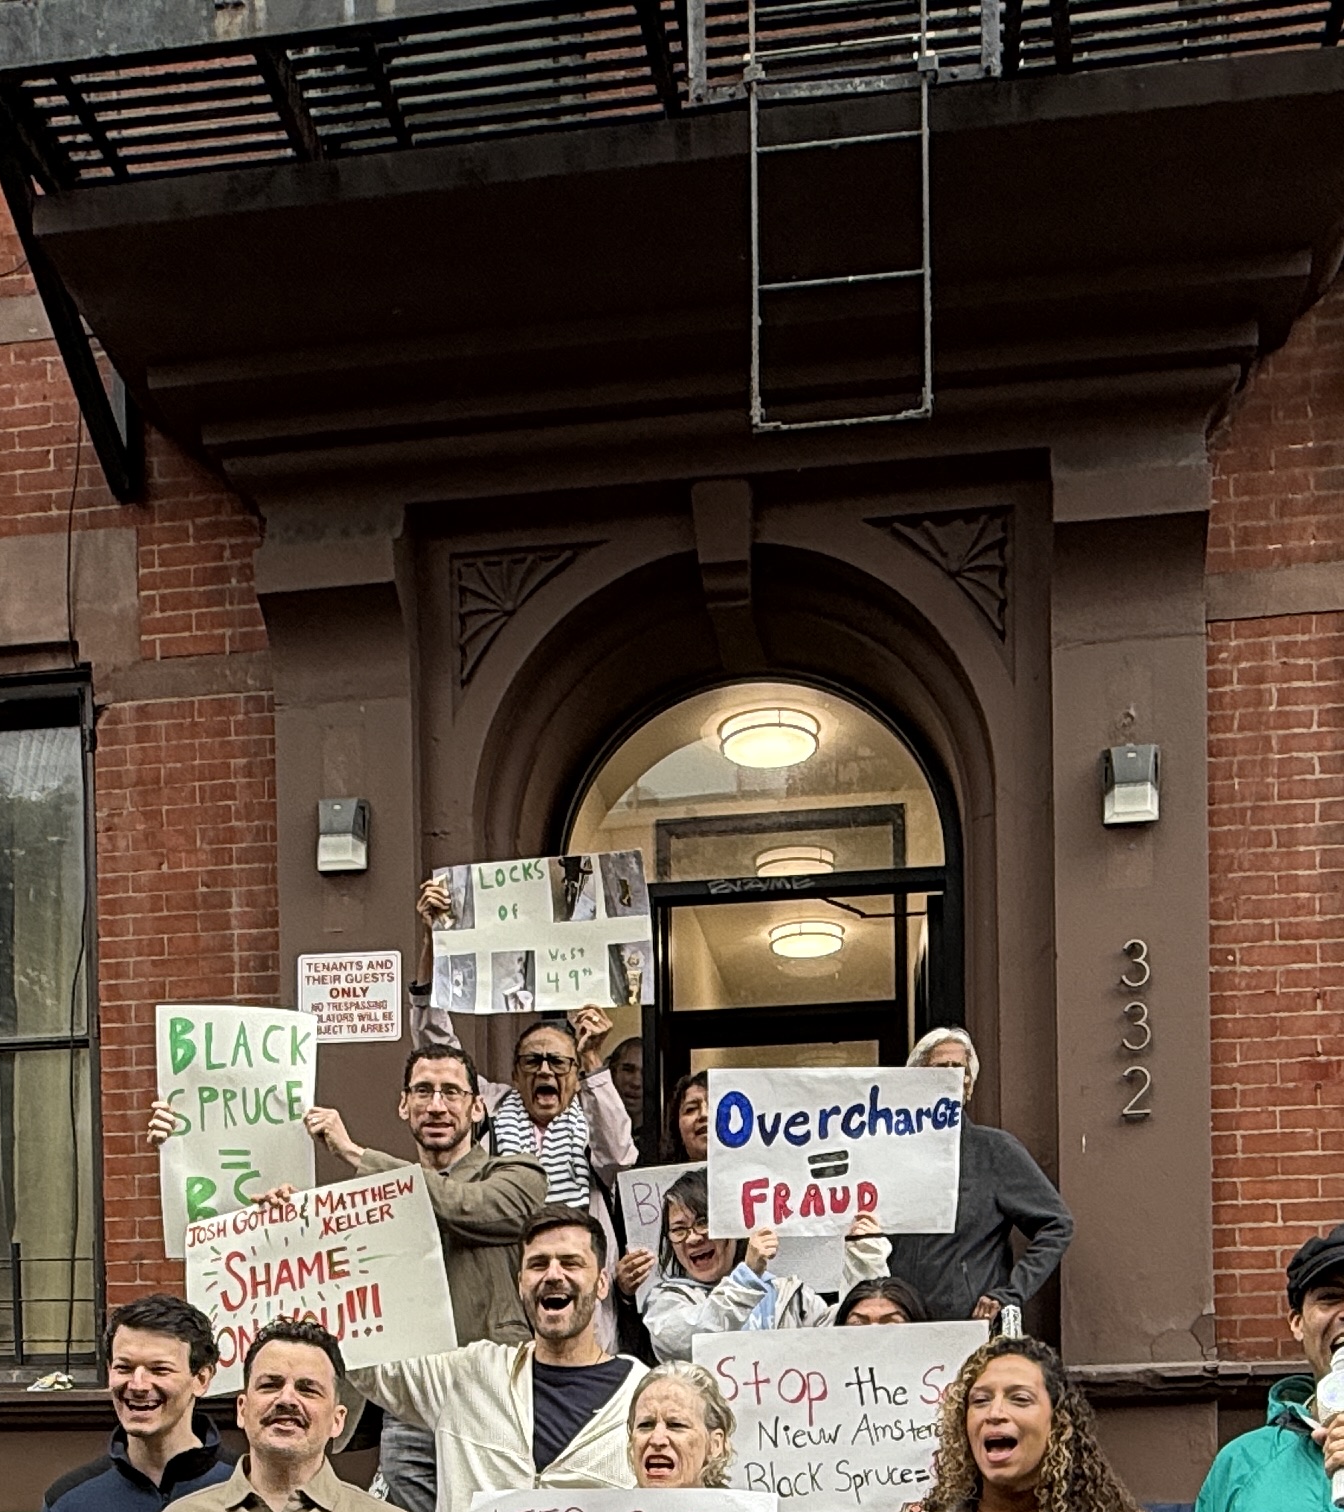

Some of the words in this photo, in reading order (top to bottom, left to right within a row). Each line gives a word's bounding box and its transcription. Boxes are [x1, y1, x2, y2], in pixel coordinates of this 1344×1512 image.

[478, 859, 545, 889] LOCKS
[305, 974, 341, 985] THEIR
[345, 972, 394, 984] GUESTS
[306, 960, 363, 972] TENANTS
[367, 959, 393, 971] AND
[311, 1002, 323, 1012] NO
[327, 1000, 387, 1012] TRESPASSING
[329, 986, 369, 999] ONLY
[317, 1013, 354, 1024] LATORS
[357, 1012, 379, 1022] WILL
[317, 1025, 343, 1035] BJECT
[346, 1024, 357, 1034] TO
[361, 1023, 395, 1034] ARREST
[1121, 939, 1152, 1115] 332
[169, 1017, 311, 1075] BLACK
[167, 1080, 303, 1136] SPRUCE
[187, 1219, 227, 1247] JOSH
[233, 1203, 297, 1235] GOTLIB
[315, 1175, 414, 1217] MATTHEW
[322, 1203, 394, 1236] KELLER
[742, 1177, 878, 1229] FRAUD
[220, 1246, 351, 1312] SHAME
[716, 1356, 828, 1426] Stop
[845, 1366, 908, 1406] the
[758, 1416, 842, 1450] Nieuw
[744, 1461, 824, 1498] Black
